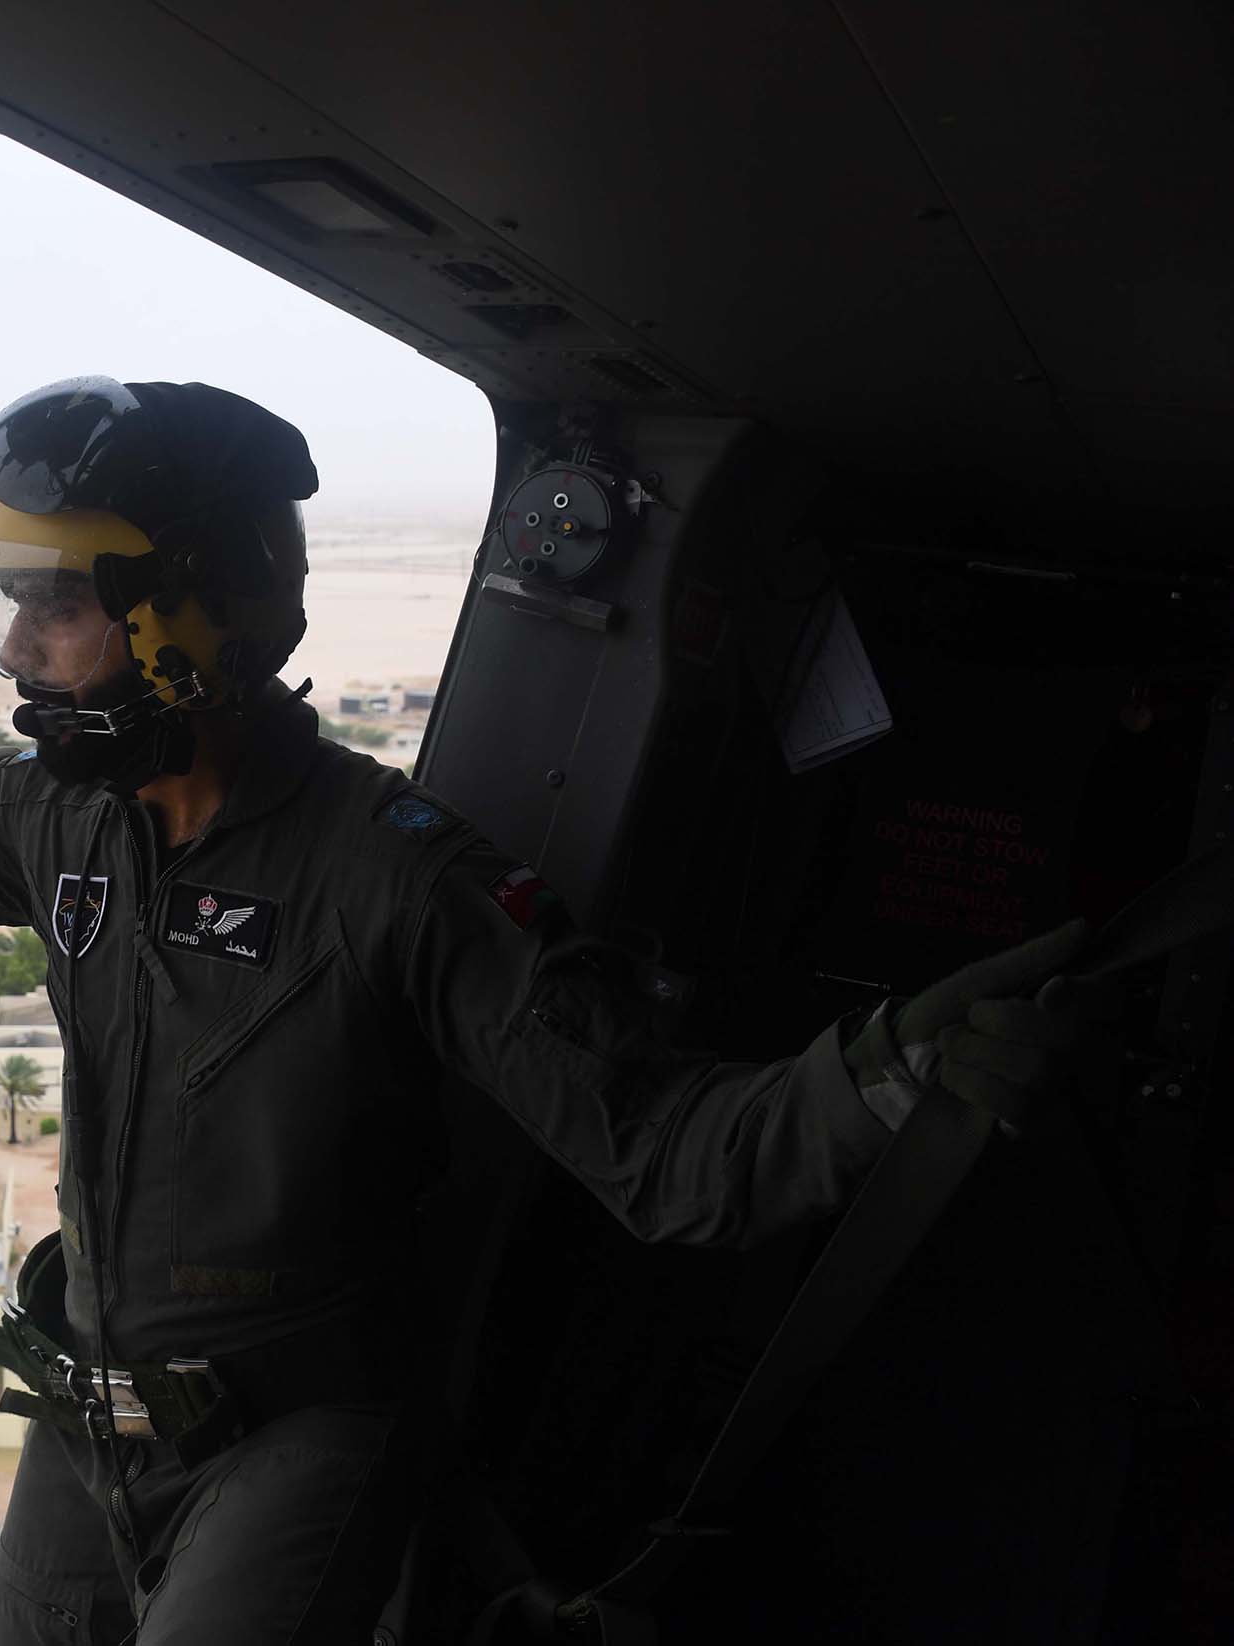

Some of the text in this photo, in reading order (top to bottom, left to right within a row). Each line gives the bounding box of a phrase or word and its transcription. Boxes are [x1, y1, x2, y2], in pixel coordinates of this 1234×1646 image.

[907, 800, 1022, 833] WARNING
[875, 821, 1049, 866] DO NOT STOW
[167, 930, 200, 945] MOHD
[225, 939, 257, 960] محمد
